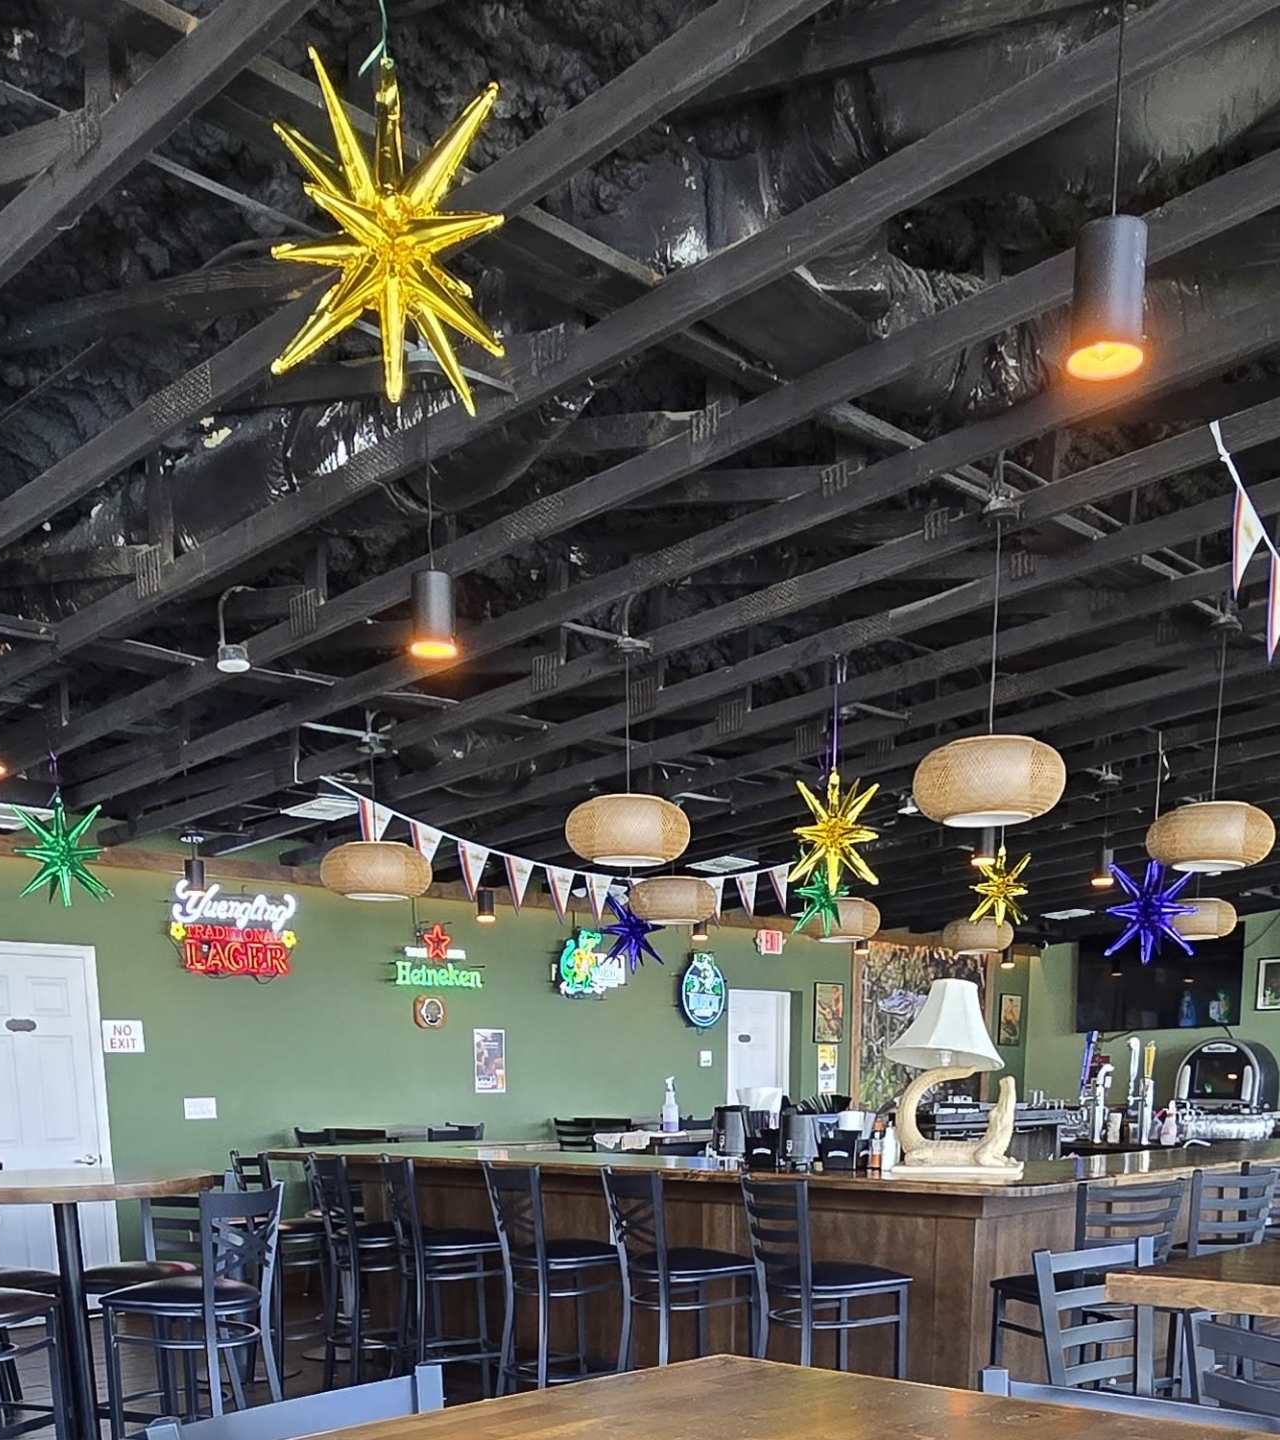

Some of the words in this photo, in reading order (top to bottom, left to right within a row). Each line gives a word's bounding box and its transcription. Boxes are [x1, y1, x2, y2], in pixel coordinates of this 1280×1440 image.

[172, 879, 296, 932] Yuengling
[185, 924, 282, 943] TRADITIONAL
[185, 940, 289, 974] LAGER
[395, 960, 483, 988] Heineken
[112, 1024, 132, 1036] NO
[109, 1038, 137, 1049] EXIT
